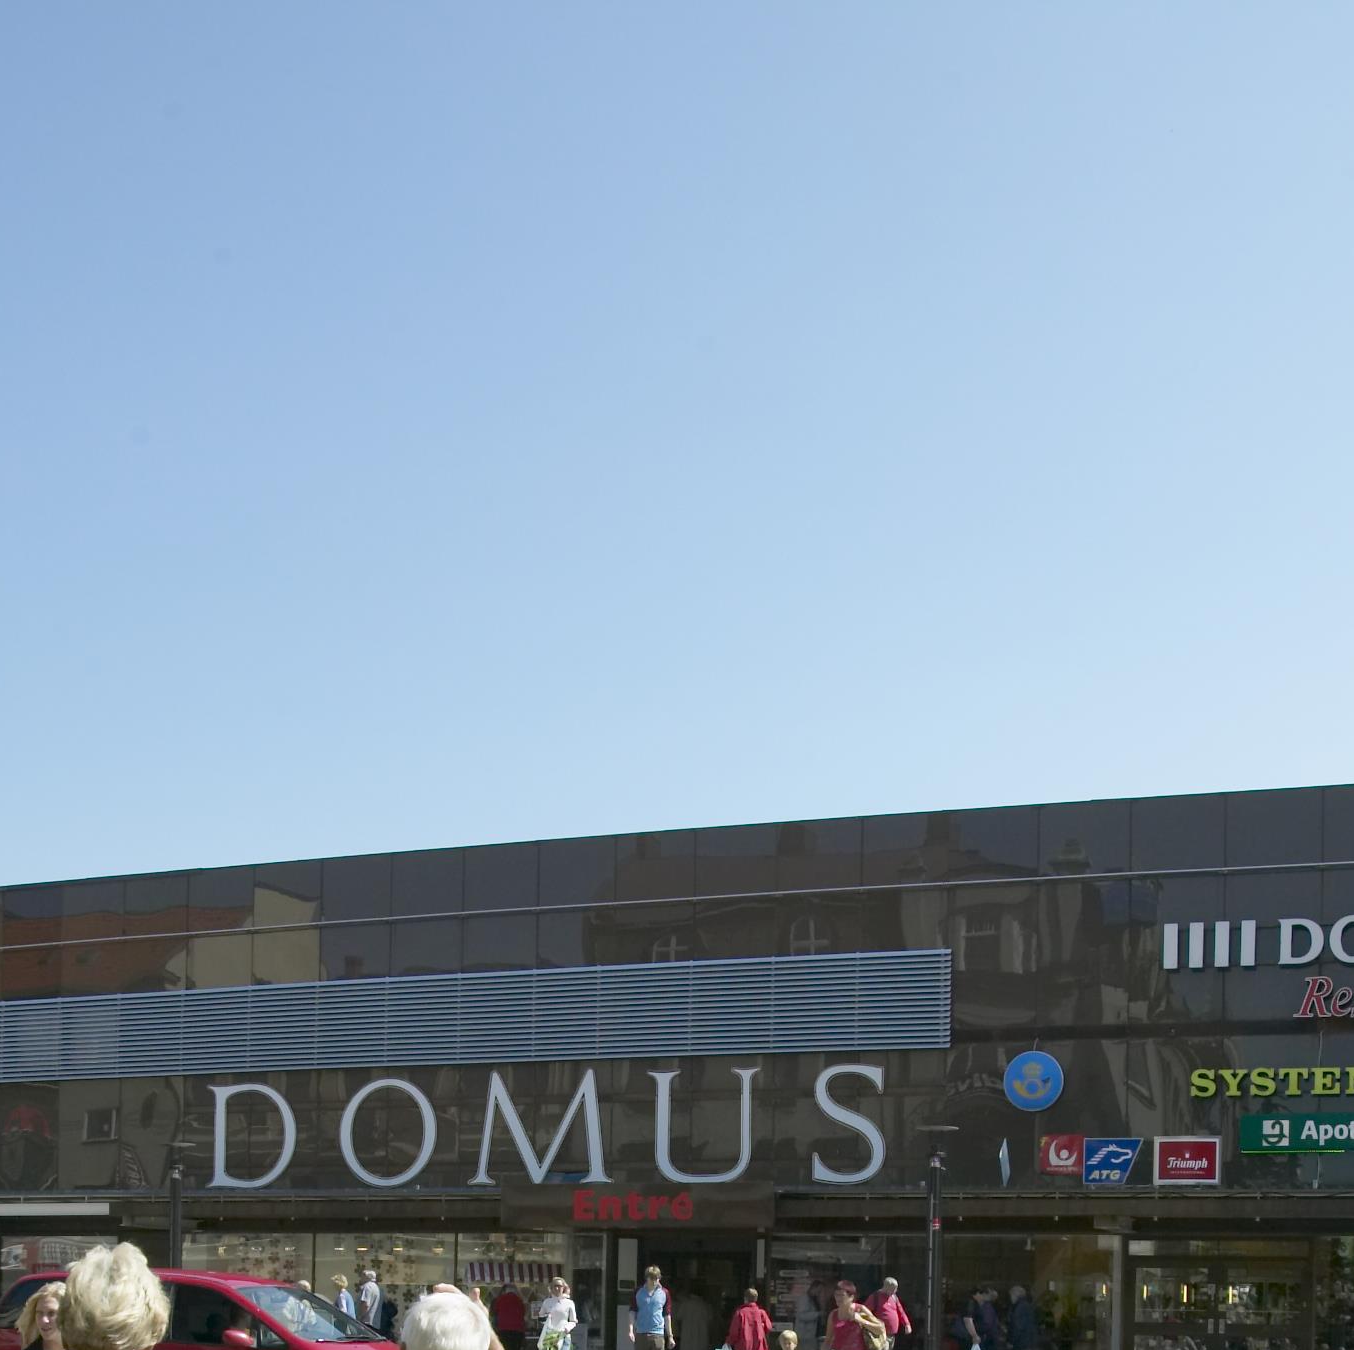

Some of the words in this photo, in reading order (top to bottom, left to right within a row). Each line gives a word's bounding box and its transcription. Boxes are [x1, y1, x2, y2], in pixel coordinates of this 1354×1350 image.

[206, 1064, 886, 1189] DOMUS
[1167, 1156, 1208, 1170] Triumph
[1089, 1170, 1120, 1180] ATG
[573, 1189, 694, 1221] Entré
